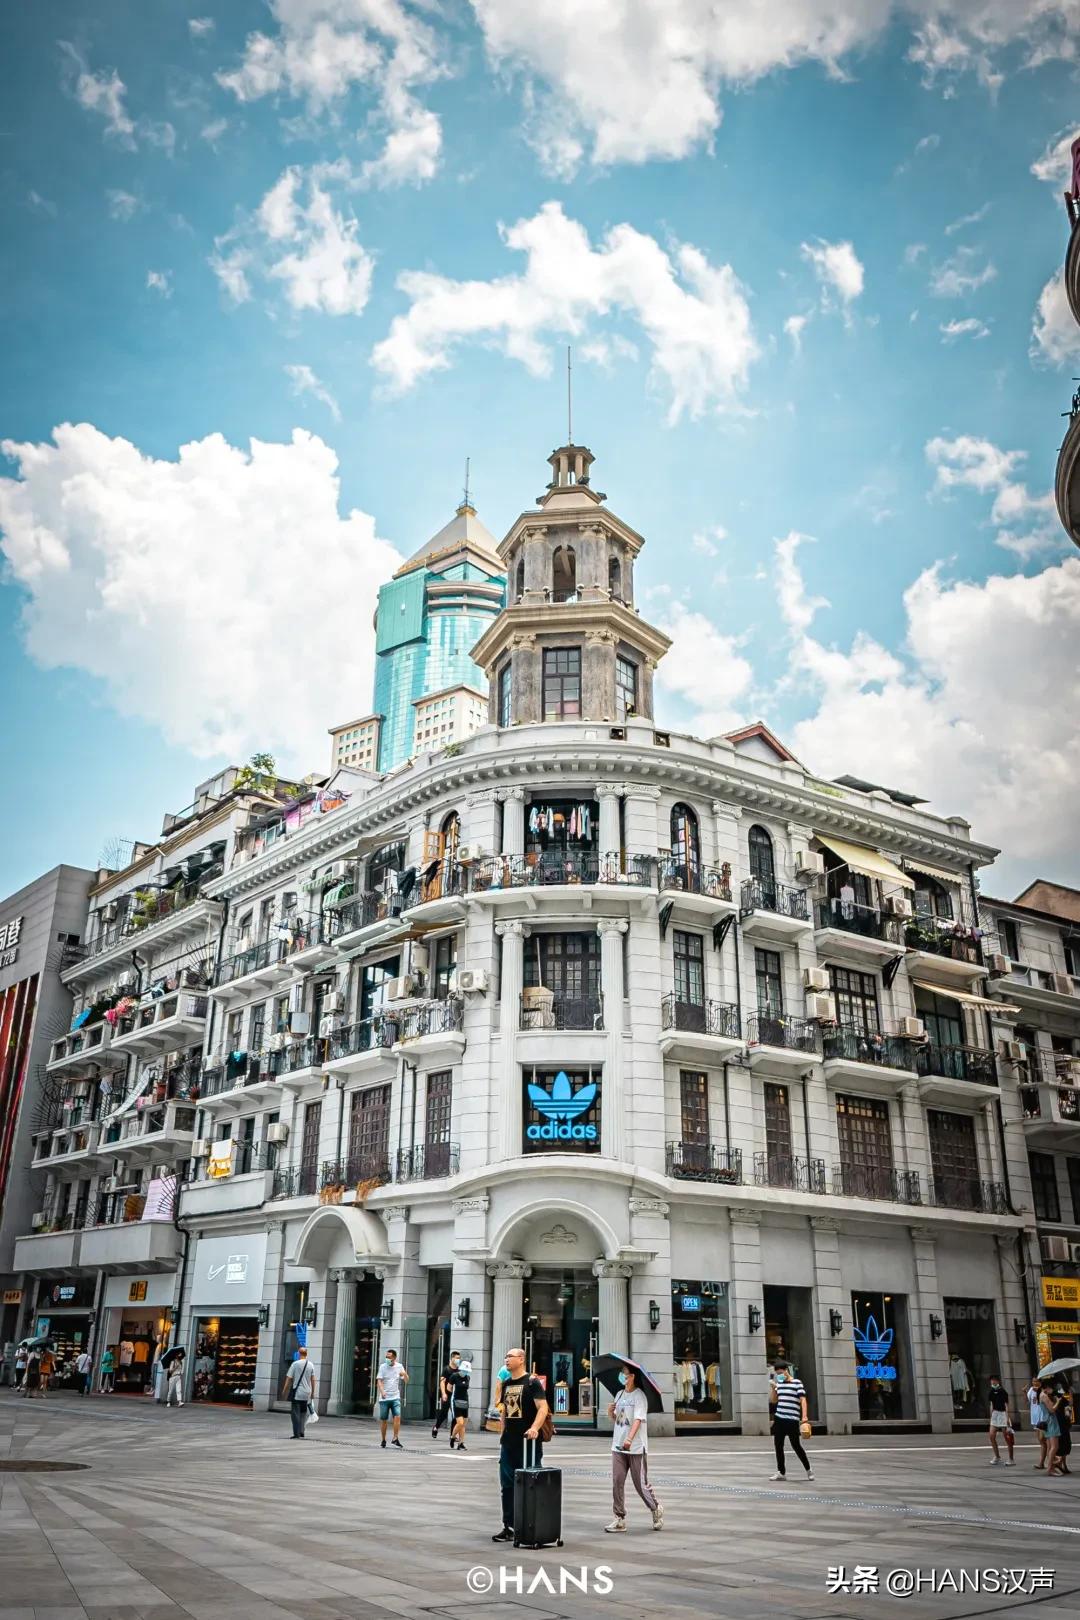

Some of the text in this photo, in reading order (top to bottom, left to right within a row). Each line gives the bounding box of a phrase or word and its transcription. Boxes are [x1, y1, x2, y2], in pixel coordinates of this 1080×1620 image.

[526, 1119, 597, 1140] adidas
[683, 1297, 698, 1307] OPEN
[856, 1363, 897, 1380] adidas
